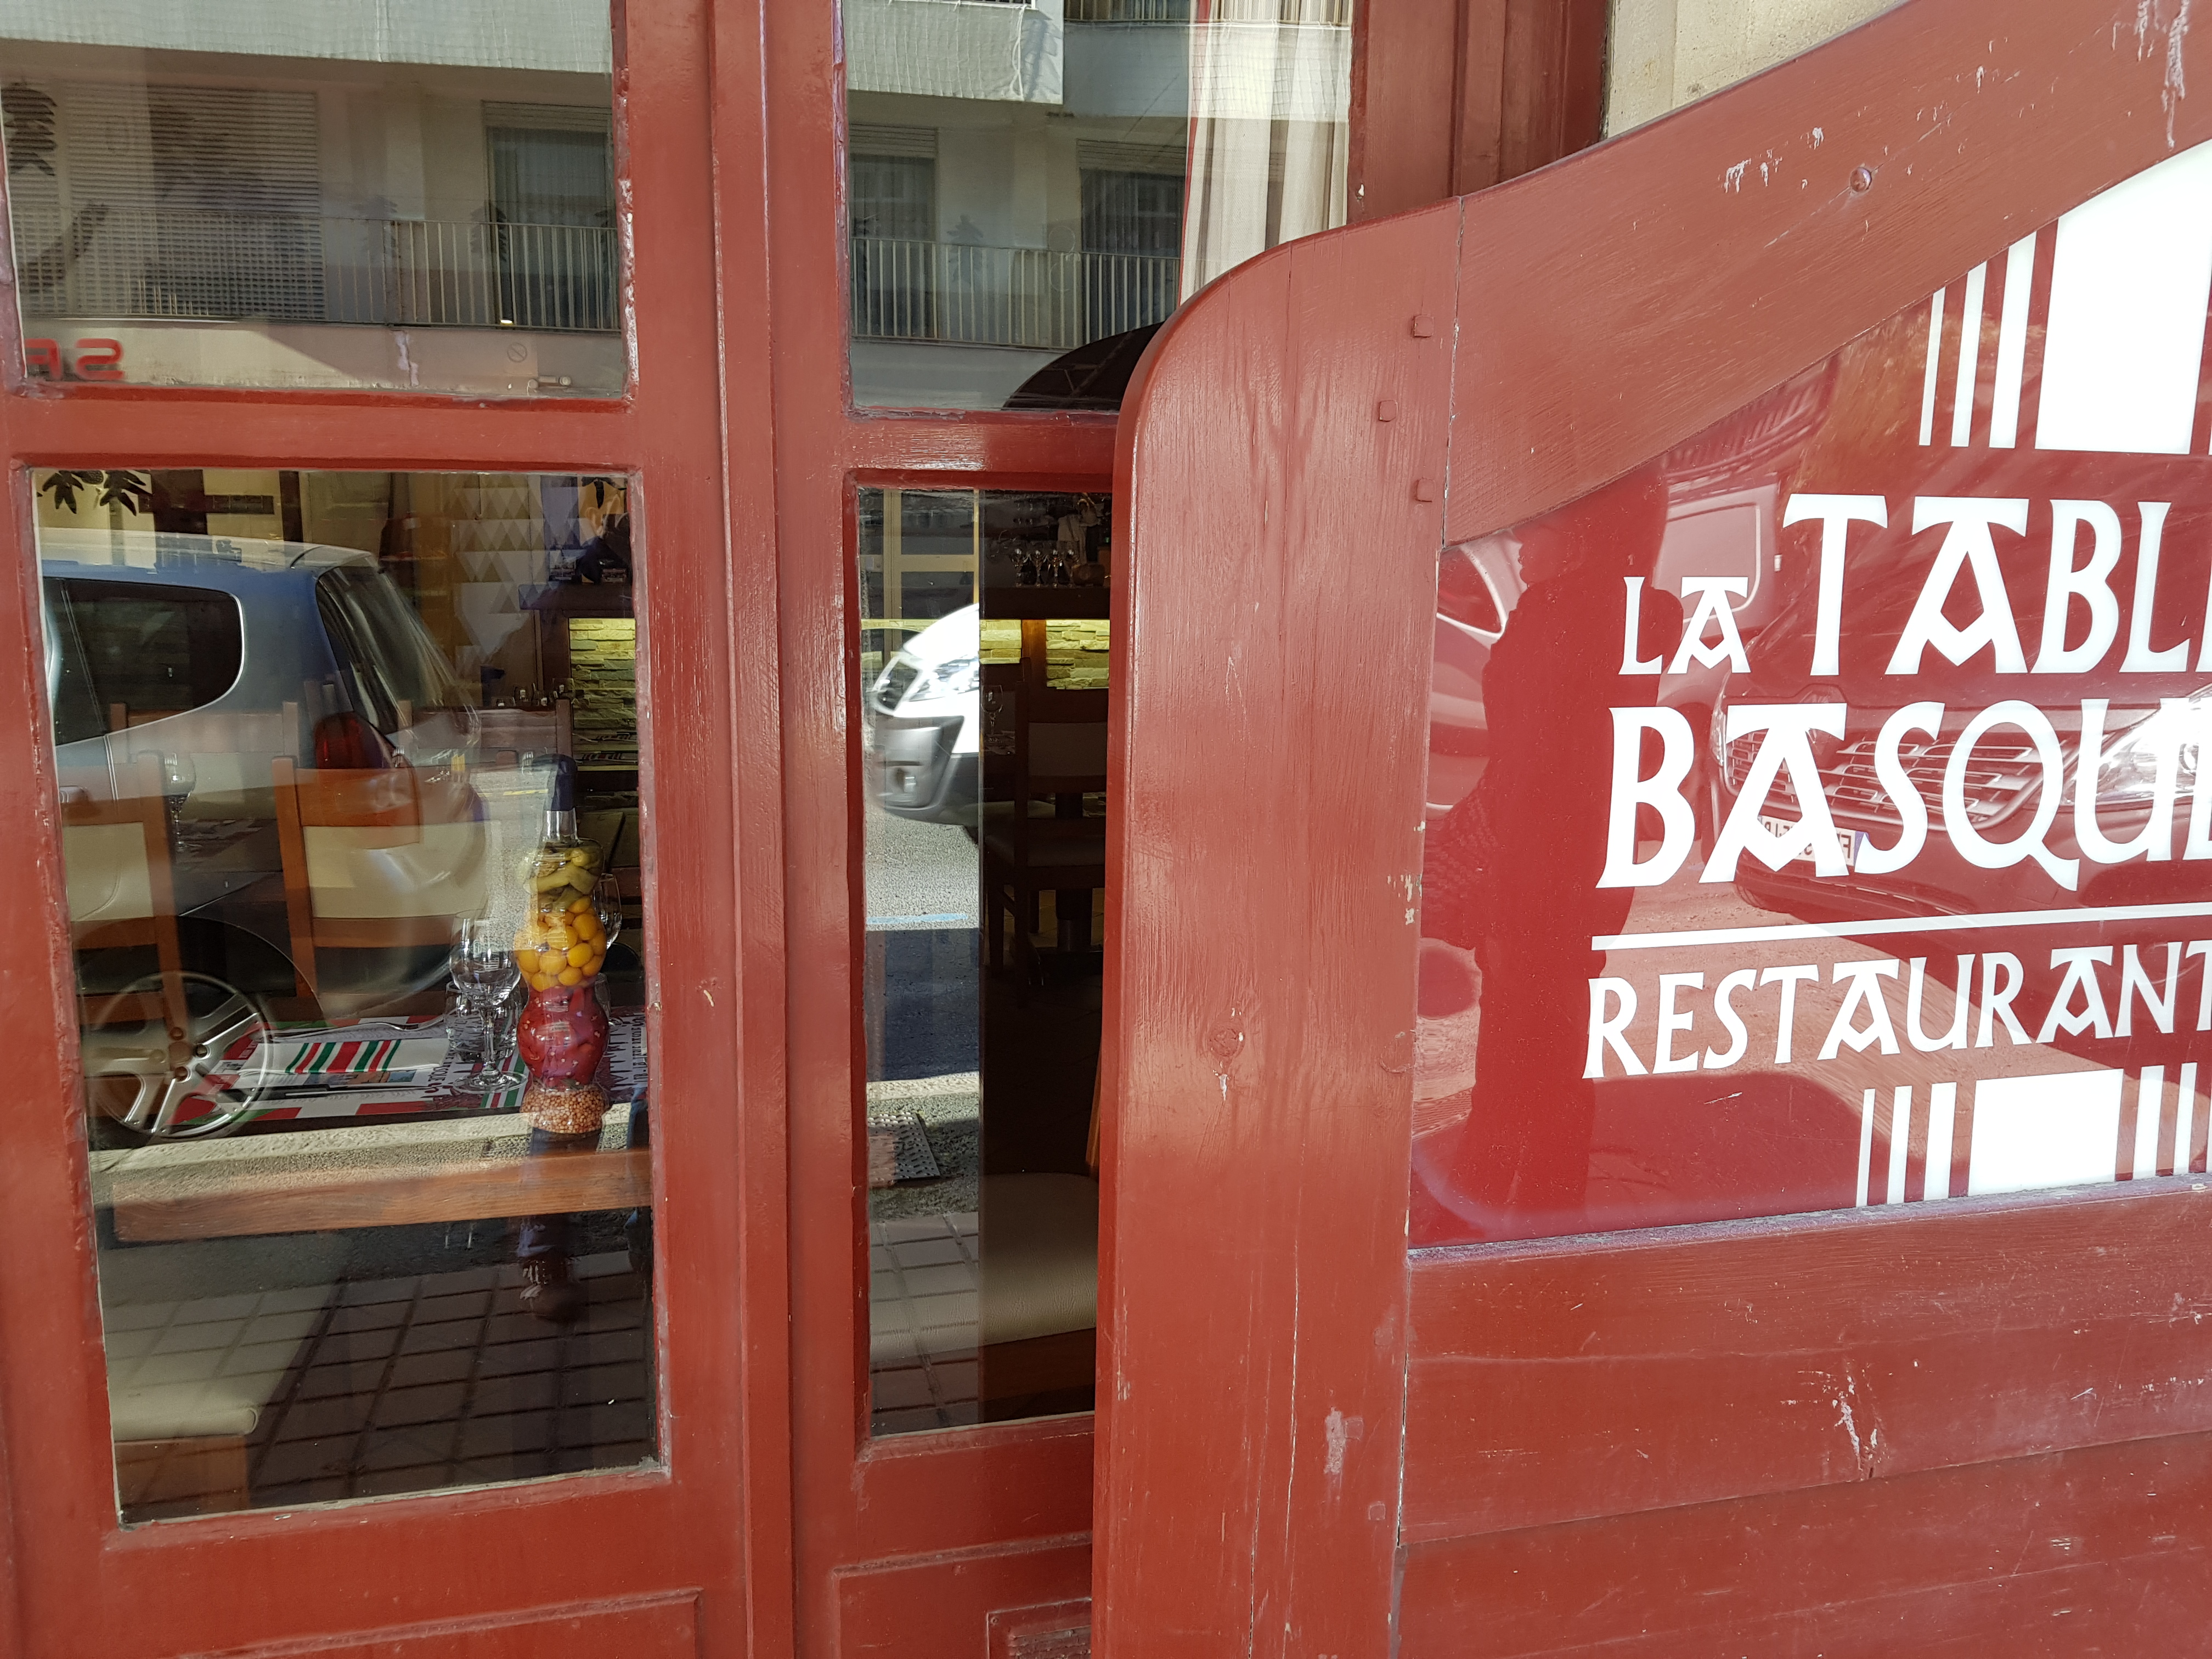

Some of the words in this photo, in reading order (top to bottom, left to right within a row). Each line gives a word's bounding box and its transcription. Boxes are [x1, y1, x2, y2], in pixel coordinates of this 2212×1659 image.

[1618, 576, 1751, 674] LA
[1782, 493, 2212, 676] TABL
[1582, 939, 2212, 1079] RESTAURANT
